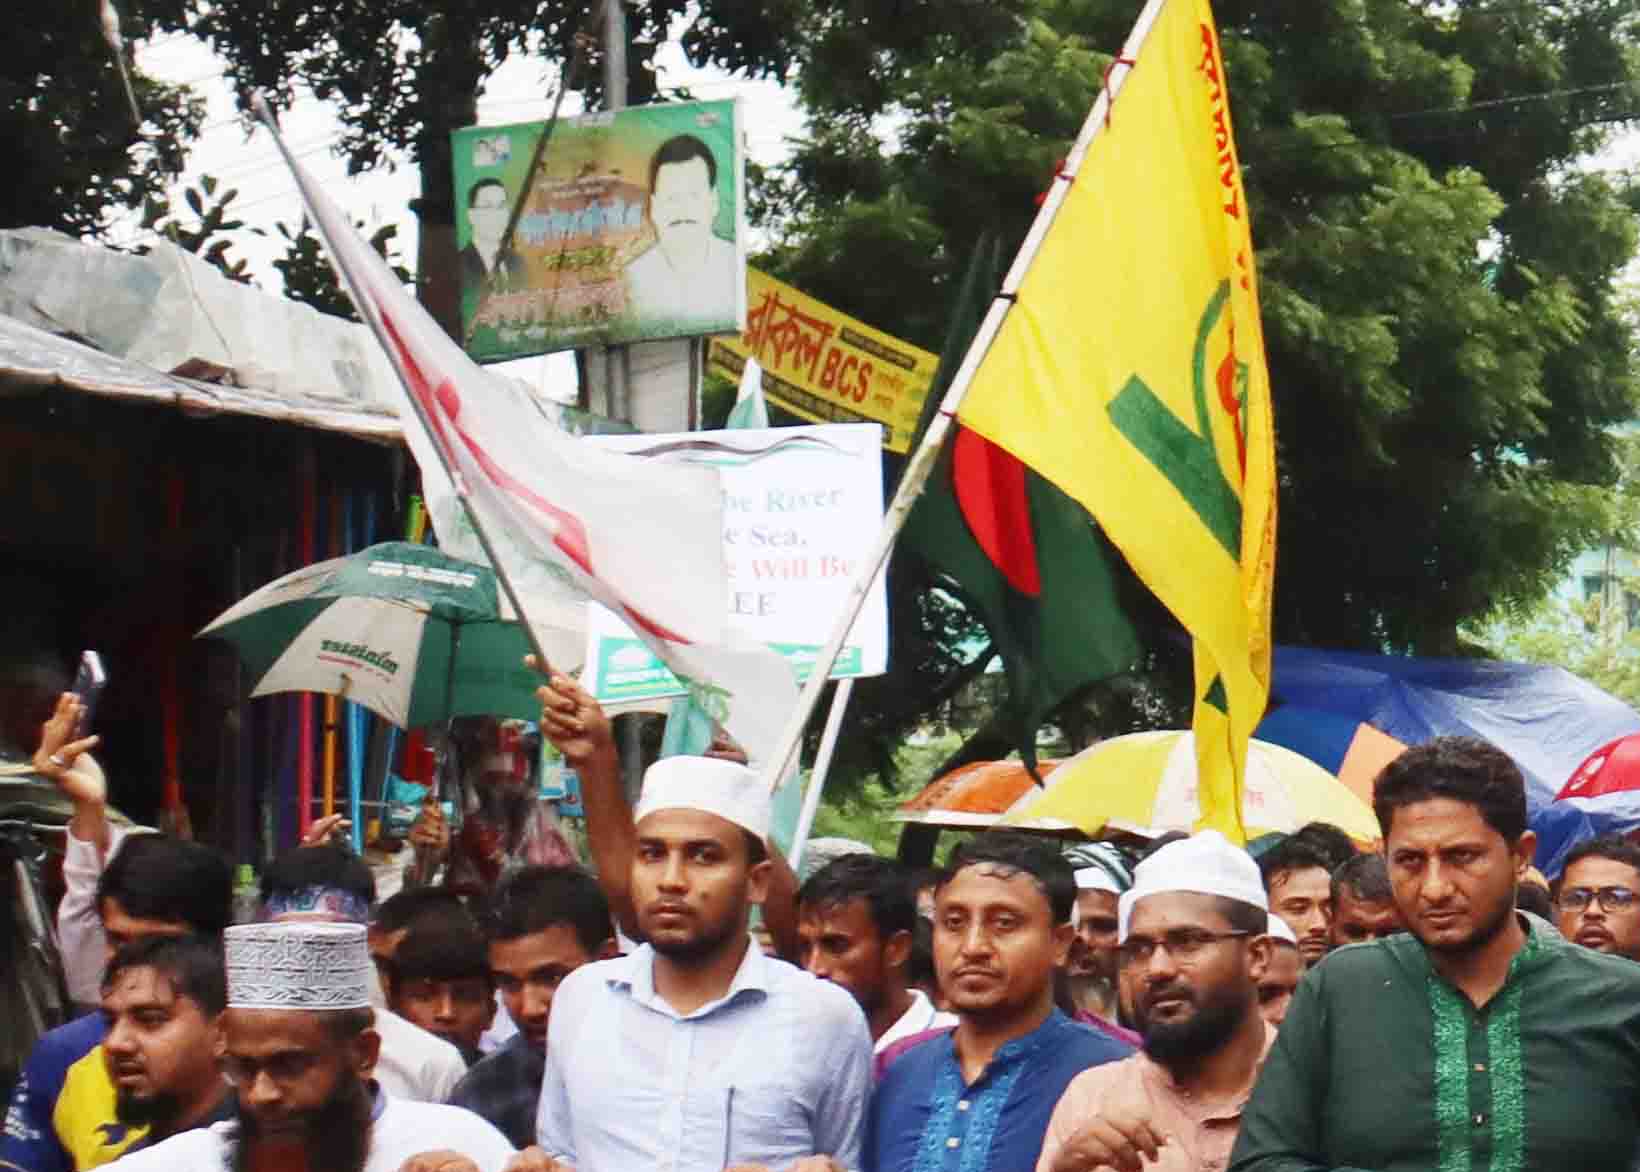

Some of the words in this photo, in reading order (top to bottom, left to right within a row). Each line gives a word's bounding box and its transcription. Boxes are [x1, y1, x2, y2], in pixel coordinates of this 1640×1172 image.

[818, 346, 873, 403] BCS
[767, 487, 843, 512] River
[752, 557, 808, 580] Will
